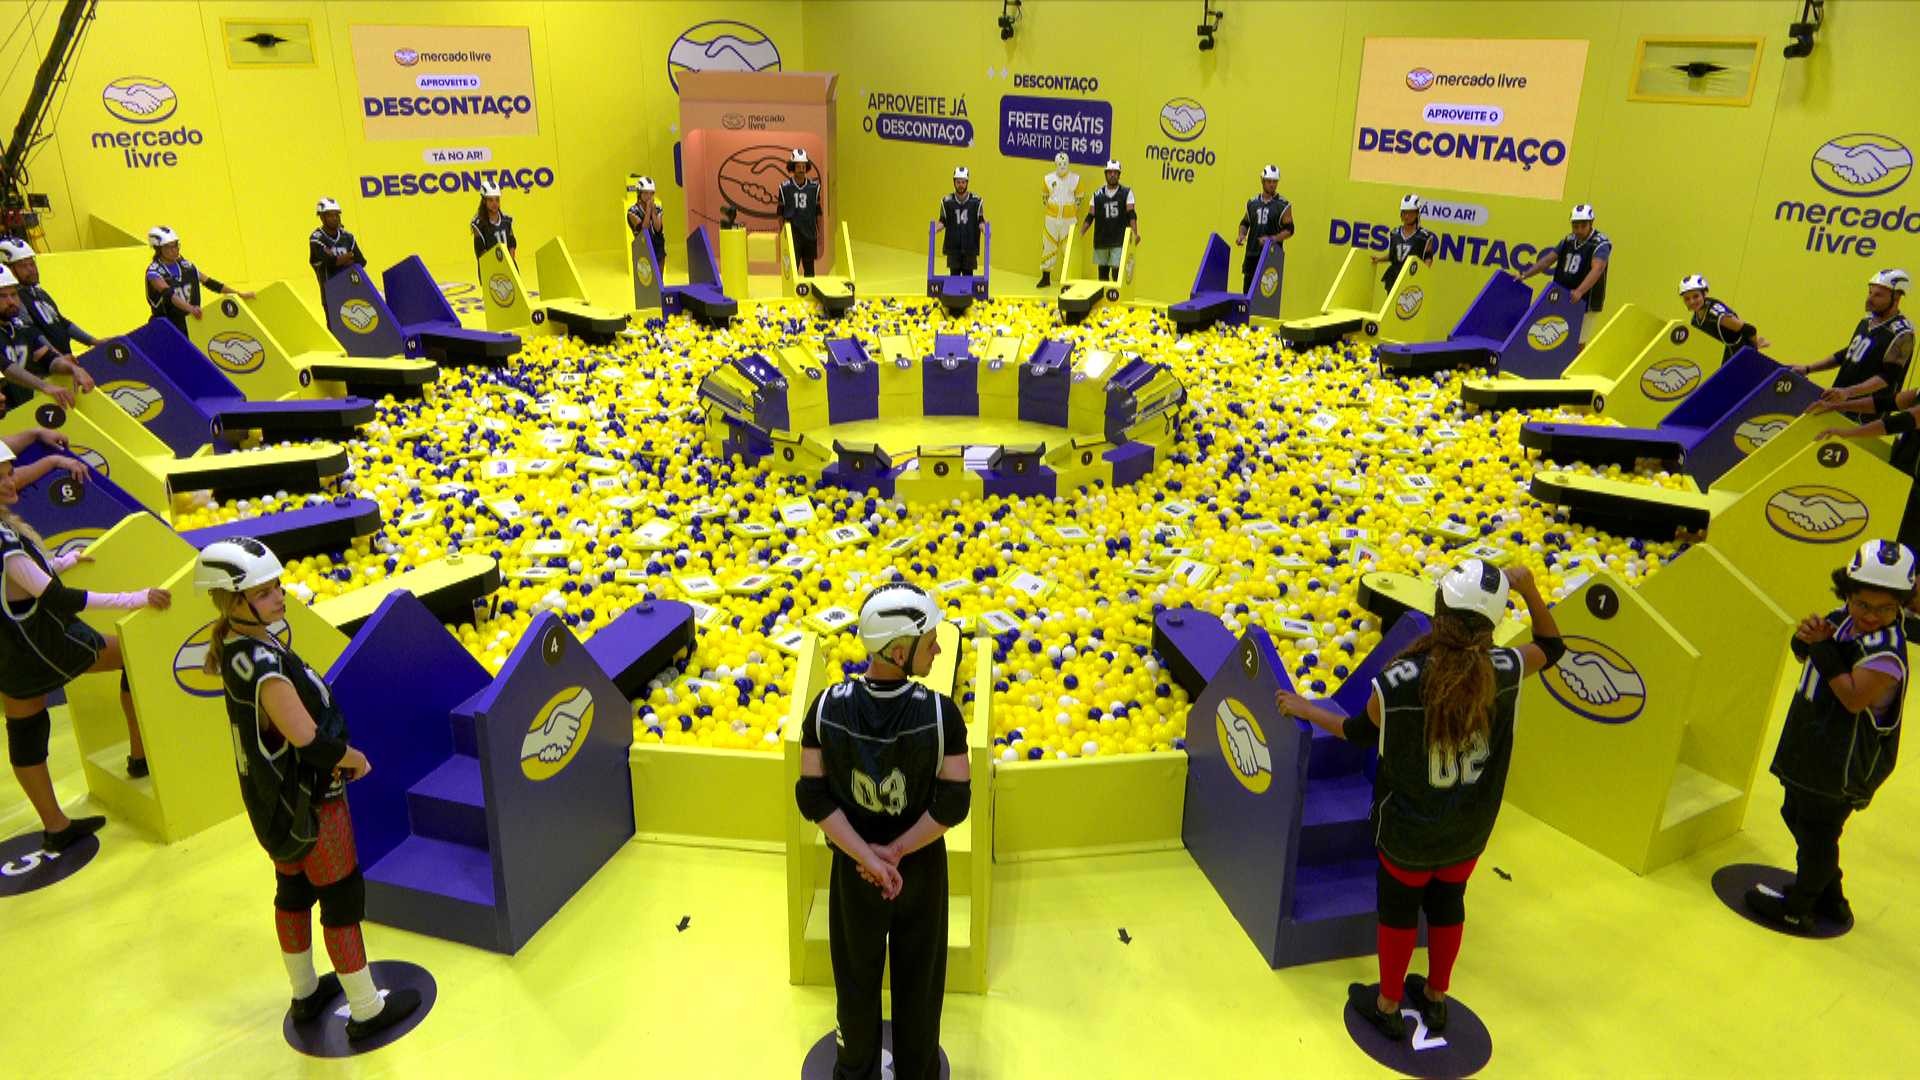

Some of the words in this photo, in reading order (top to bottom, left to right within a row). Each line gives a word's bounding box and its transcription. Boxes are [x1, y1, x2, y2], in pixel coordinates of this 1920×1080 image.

[421, 50, 468, 63] mercado
[469, 51, 492, 62] livre
[421, 79, 468, 87] APROVEITE
[1013, 74, 1099, 95] DESCONTAÇO
[1436, 73, 1495, 88] mercado
[1498, 73, 1527, 89] livre
[364, 95, 532, 119] DESCONTAÇO
[868, 93, 946, 116] APROVEITE
[950, 93, 968, 117] JÁ
[748, 113, 785, 123] mercado
[1008, 111, 1049, 132] FRETE
[1052, 110, 1104, 135] GRÁTIS
[1427, 109, 1488, 122] APROVEITE
[1490, 112, 1499, 122] O
[748, 121, 766, 131] livre
[863, 116, 873, 132] O
[882, 119, 965, 145] DESCONTAÇO
[91, 126, 203, 148] mercado
[1007, 132, 1015, 146] A
[1017, 133, 1051, 150] PARTIR
[1054, 136, 1069, 151] DE
[1071, 138, 1088, 154] R$
[1090, 140, 1104, 154] 19
[125, 149, 178, 168] livre
[432, 150, 446, 161] TÁ
[448, 152, 464, 161] NO
[466, 151, 484, 161] AR!
[1146, 145, 1216, 167] mercado
[1358, 127, 1567, 171] DESCONTAÇO
[360, 167, 554, 198] DESCONTAÇO
[1162, 162, 1195, 184] livre
[794, 192, 808, 209] 13
[954, 208, 969, 225] 14
[1103, 202, 1119, 219] 15
[1432, 207, 1451, 219] NO
[1455, 208, 1477, 221] AR!
[1774, 200, 1920, 234] mercado
[1805, 225, 1877, 257] livre
[1564, 252, 1582, 274] 18
[1674, 331, 1686, 341] 19
[1846, 335, 1871, 362] 20
[1775, 381, 1792, 393] 20
[45, 410, 55, 424] 7
[1822, 449, 1842, 463] 21
[61, 483, 74, 500] 6
[1598, 594, 1607, 610] 1
[550, 636, 559, 654] 4
[231, 646, 278, 683] 04
[1245, 649, 1253, 668] 2
[1428, 730, 1490, 789] 02
[851, 767, 907, 817] 03
[1400, 1008, 1448, 1051] 2
